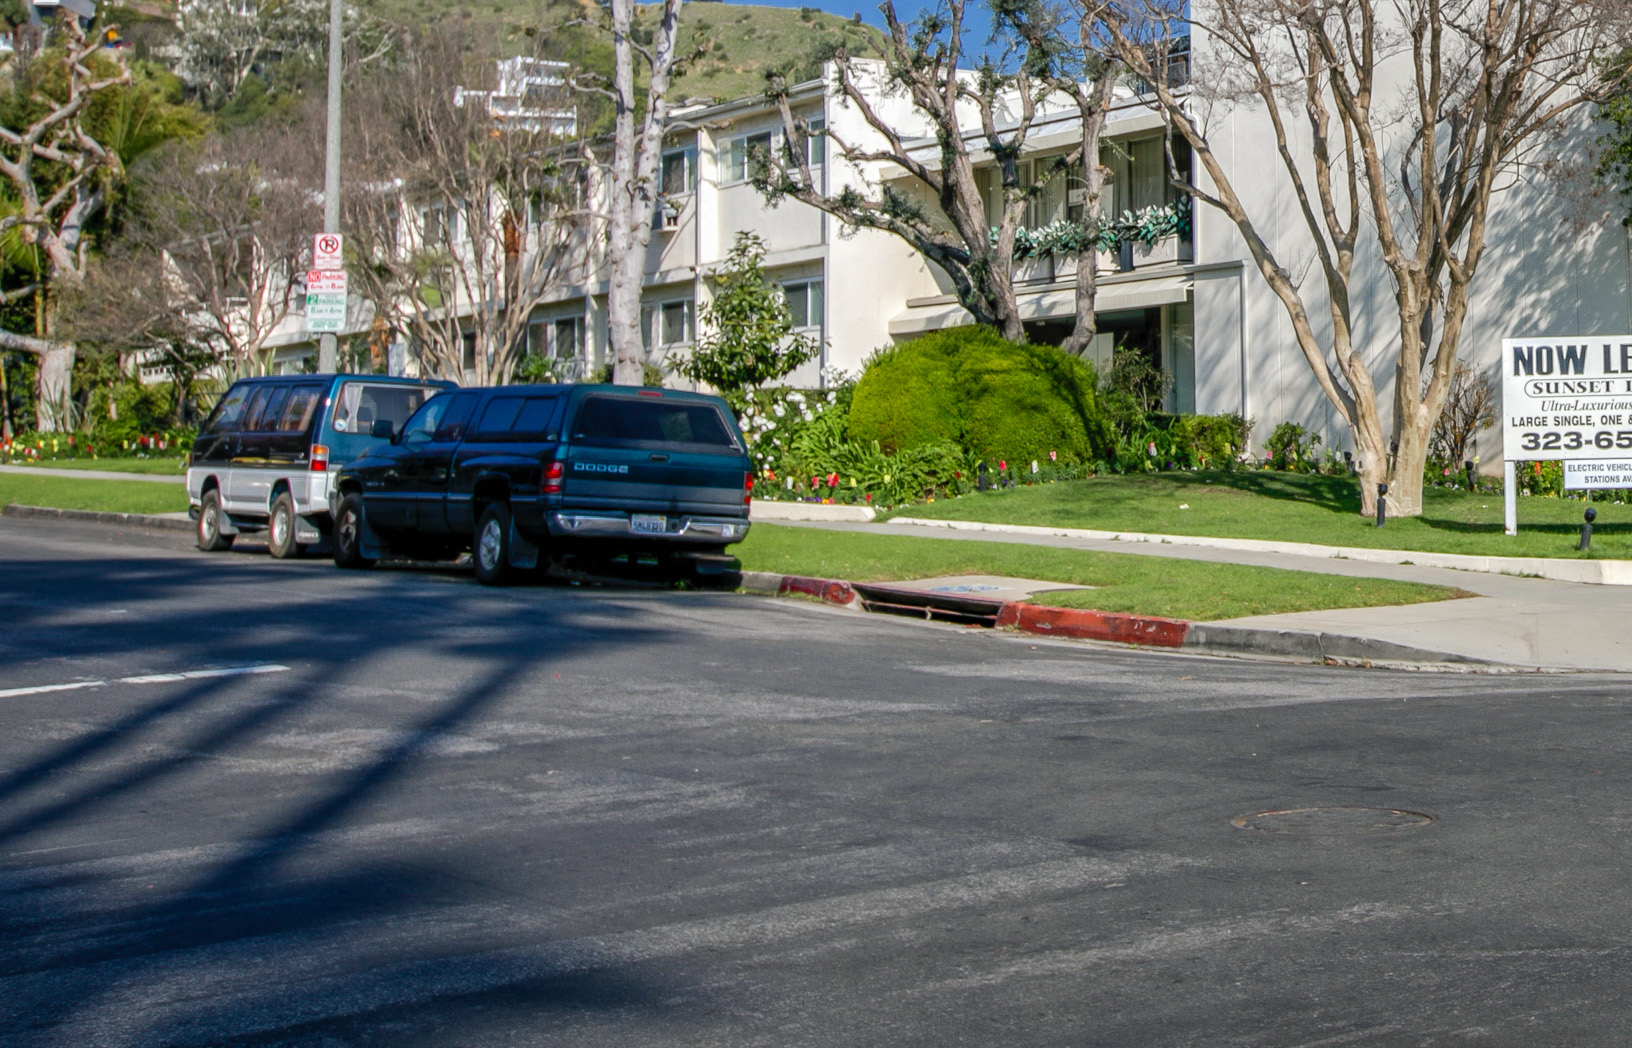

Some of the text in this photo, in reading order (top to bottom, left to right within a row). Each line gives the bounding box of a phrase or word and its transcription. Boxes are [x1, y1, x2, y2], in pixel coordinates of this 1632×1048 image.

[1512, 344, 1588, 377] NOW
[1532, 380, 1615, 395] SUNSET
[1511, 416, 1548, 428] LARGE
[1553, 415, 1596, 428] SINGLE,
[1600, 414, 1623, 426] ONE
[574, 462, 629, 474] DODGE
[1567, 463, 1605, 472] ELECTRIC
[1584, 475, 1620, 484] STATIONS
